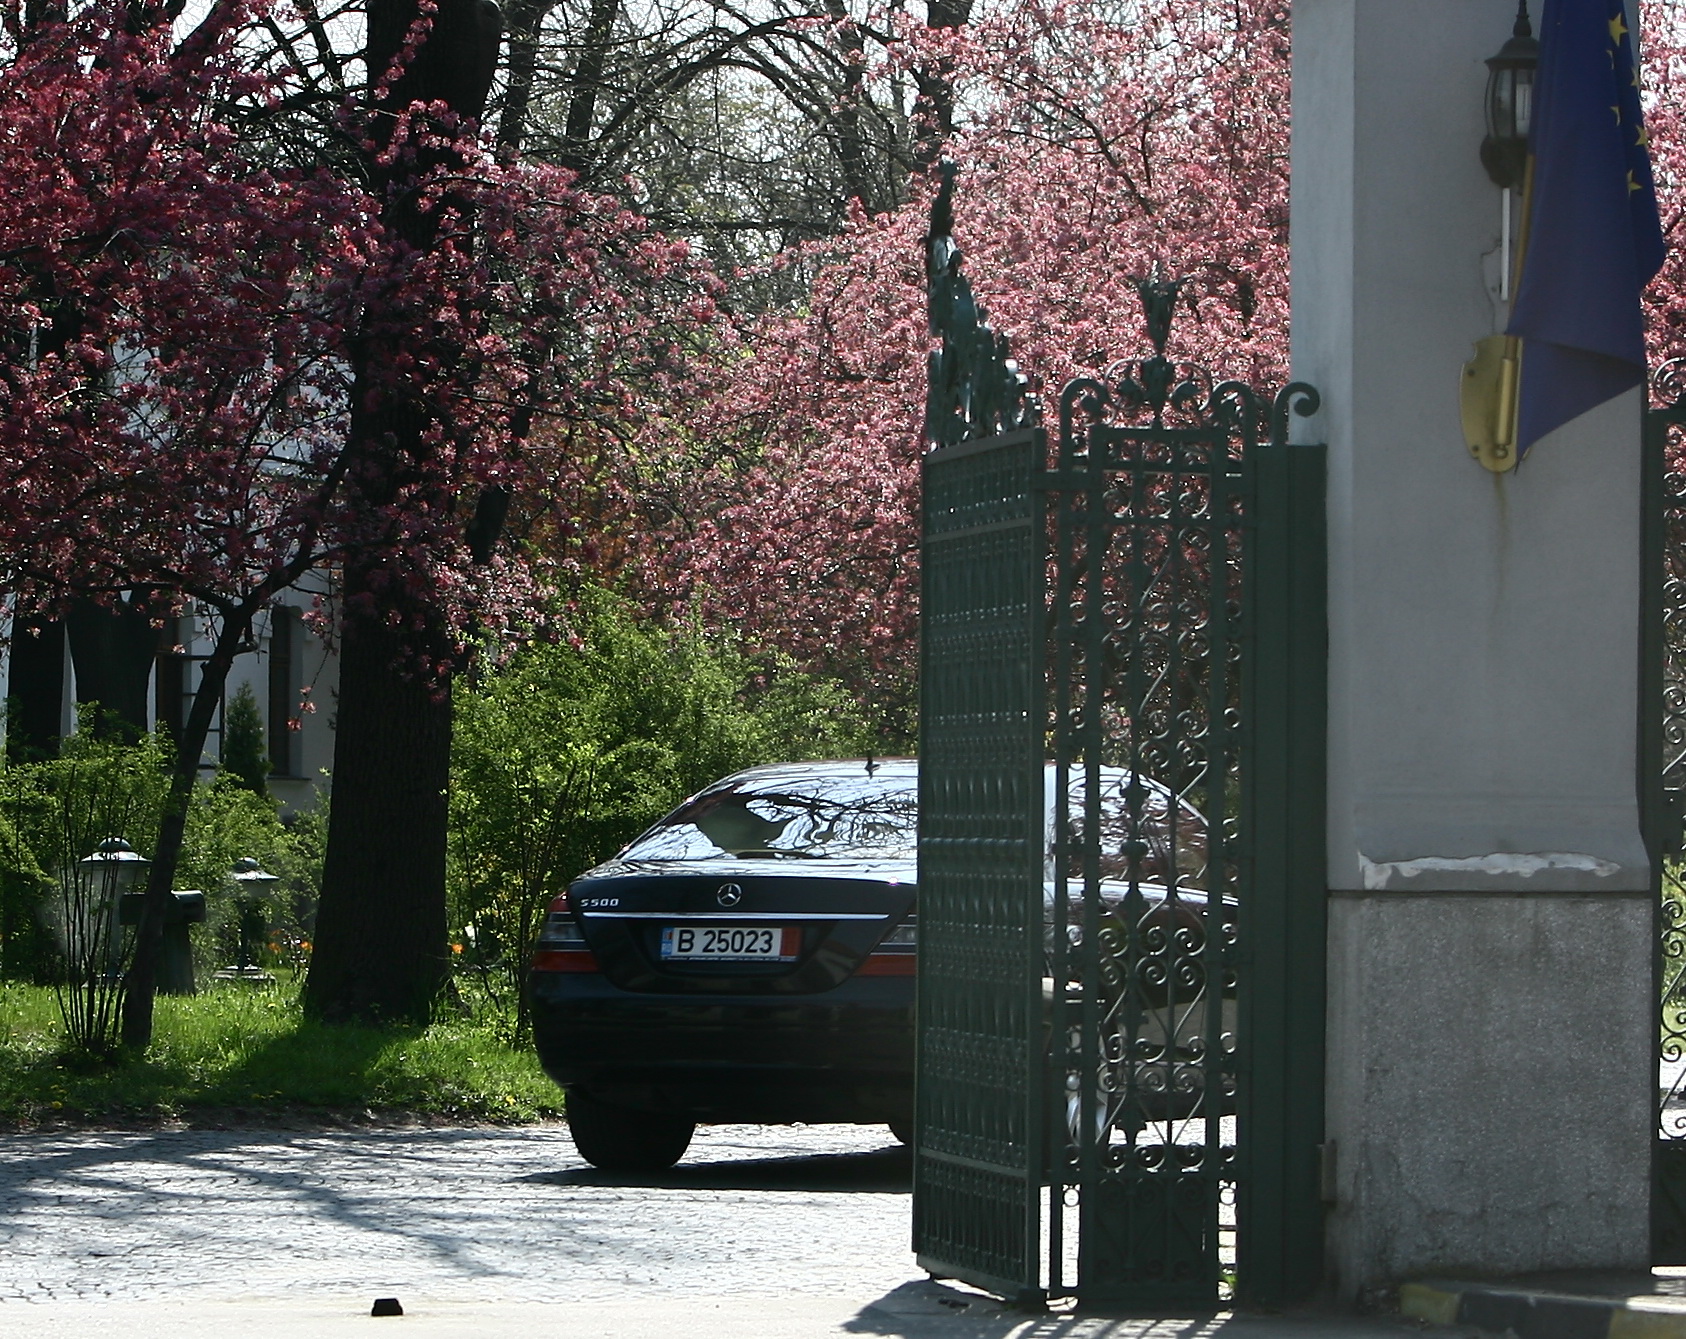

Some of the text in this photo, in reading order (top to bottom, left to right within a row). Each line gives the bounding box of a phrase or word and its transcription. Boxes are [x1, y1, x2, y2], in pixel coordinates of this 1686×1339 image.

[580, 898, 619, 907] S500
[677, 929, 695, 953] B
[702, 929, 774, 953] 25023
